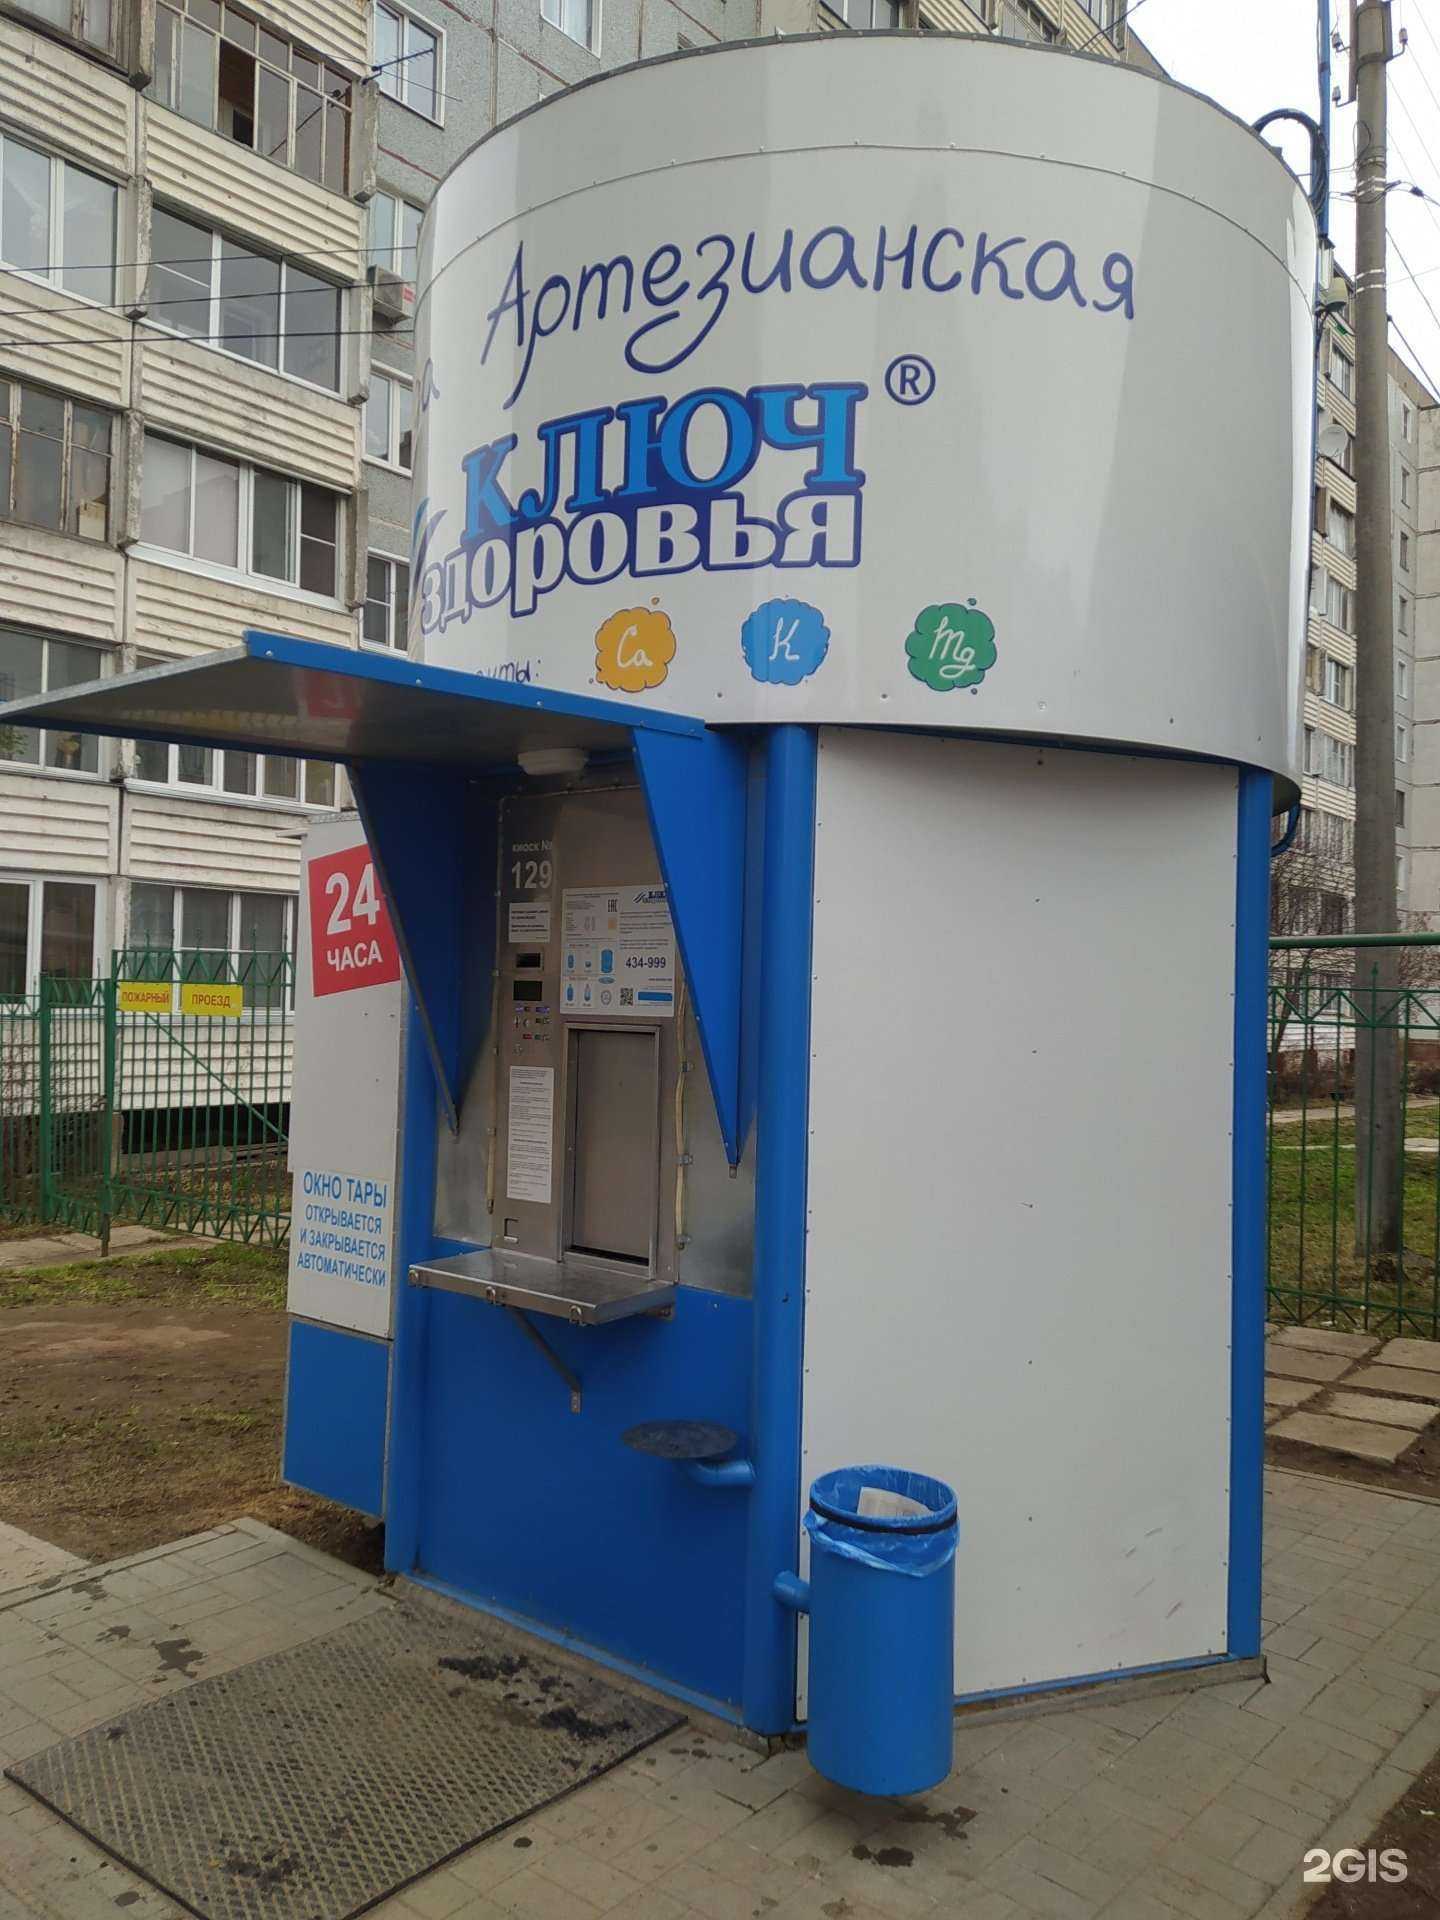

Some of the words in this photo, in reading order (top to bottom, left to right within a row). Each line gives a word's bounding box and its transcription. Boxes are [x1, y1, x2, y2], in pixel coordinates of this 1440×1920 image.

[481, 225, 1135, 410] Артезианская
[512, 861, 553, 889] 129
[325, 862, 382, 936] 24
[326, 939, 384, 973] ЧАСА
[625, 956, 667, 969] 434-999
[121, 990, 170, 1004] ПОЖАРНЫЙ
[191, 993, 232, 1008] ПРОЕЗД
[303, 1171, 342, 1200] ОКНО
[346, 1178, 387, 1208] ТАРЫ
[305, 1204, 383, 1234] ОТКРЫВАЕТСЯ
[300, 1228, 307, 1243] И
[308, 1229, 386, 1261] ЗАКРЫВАЕТСЯ
[296, 1251, 387, 1287] АВТОМАТИЧЕСКИ
